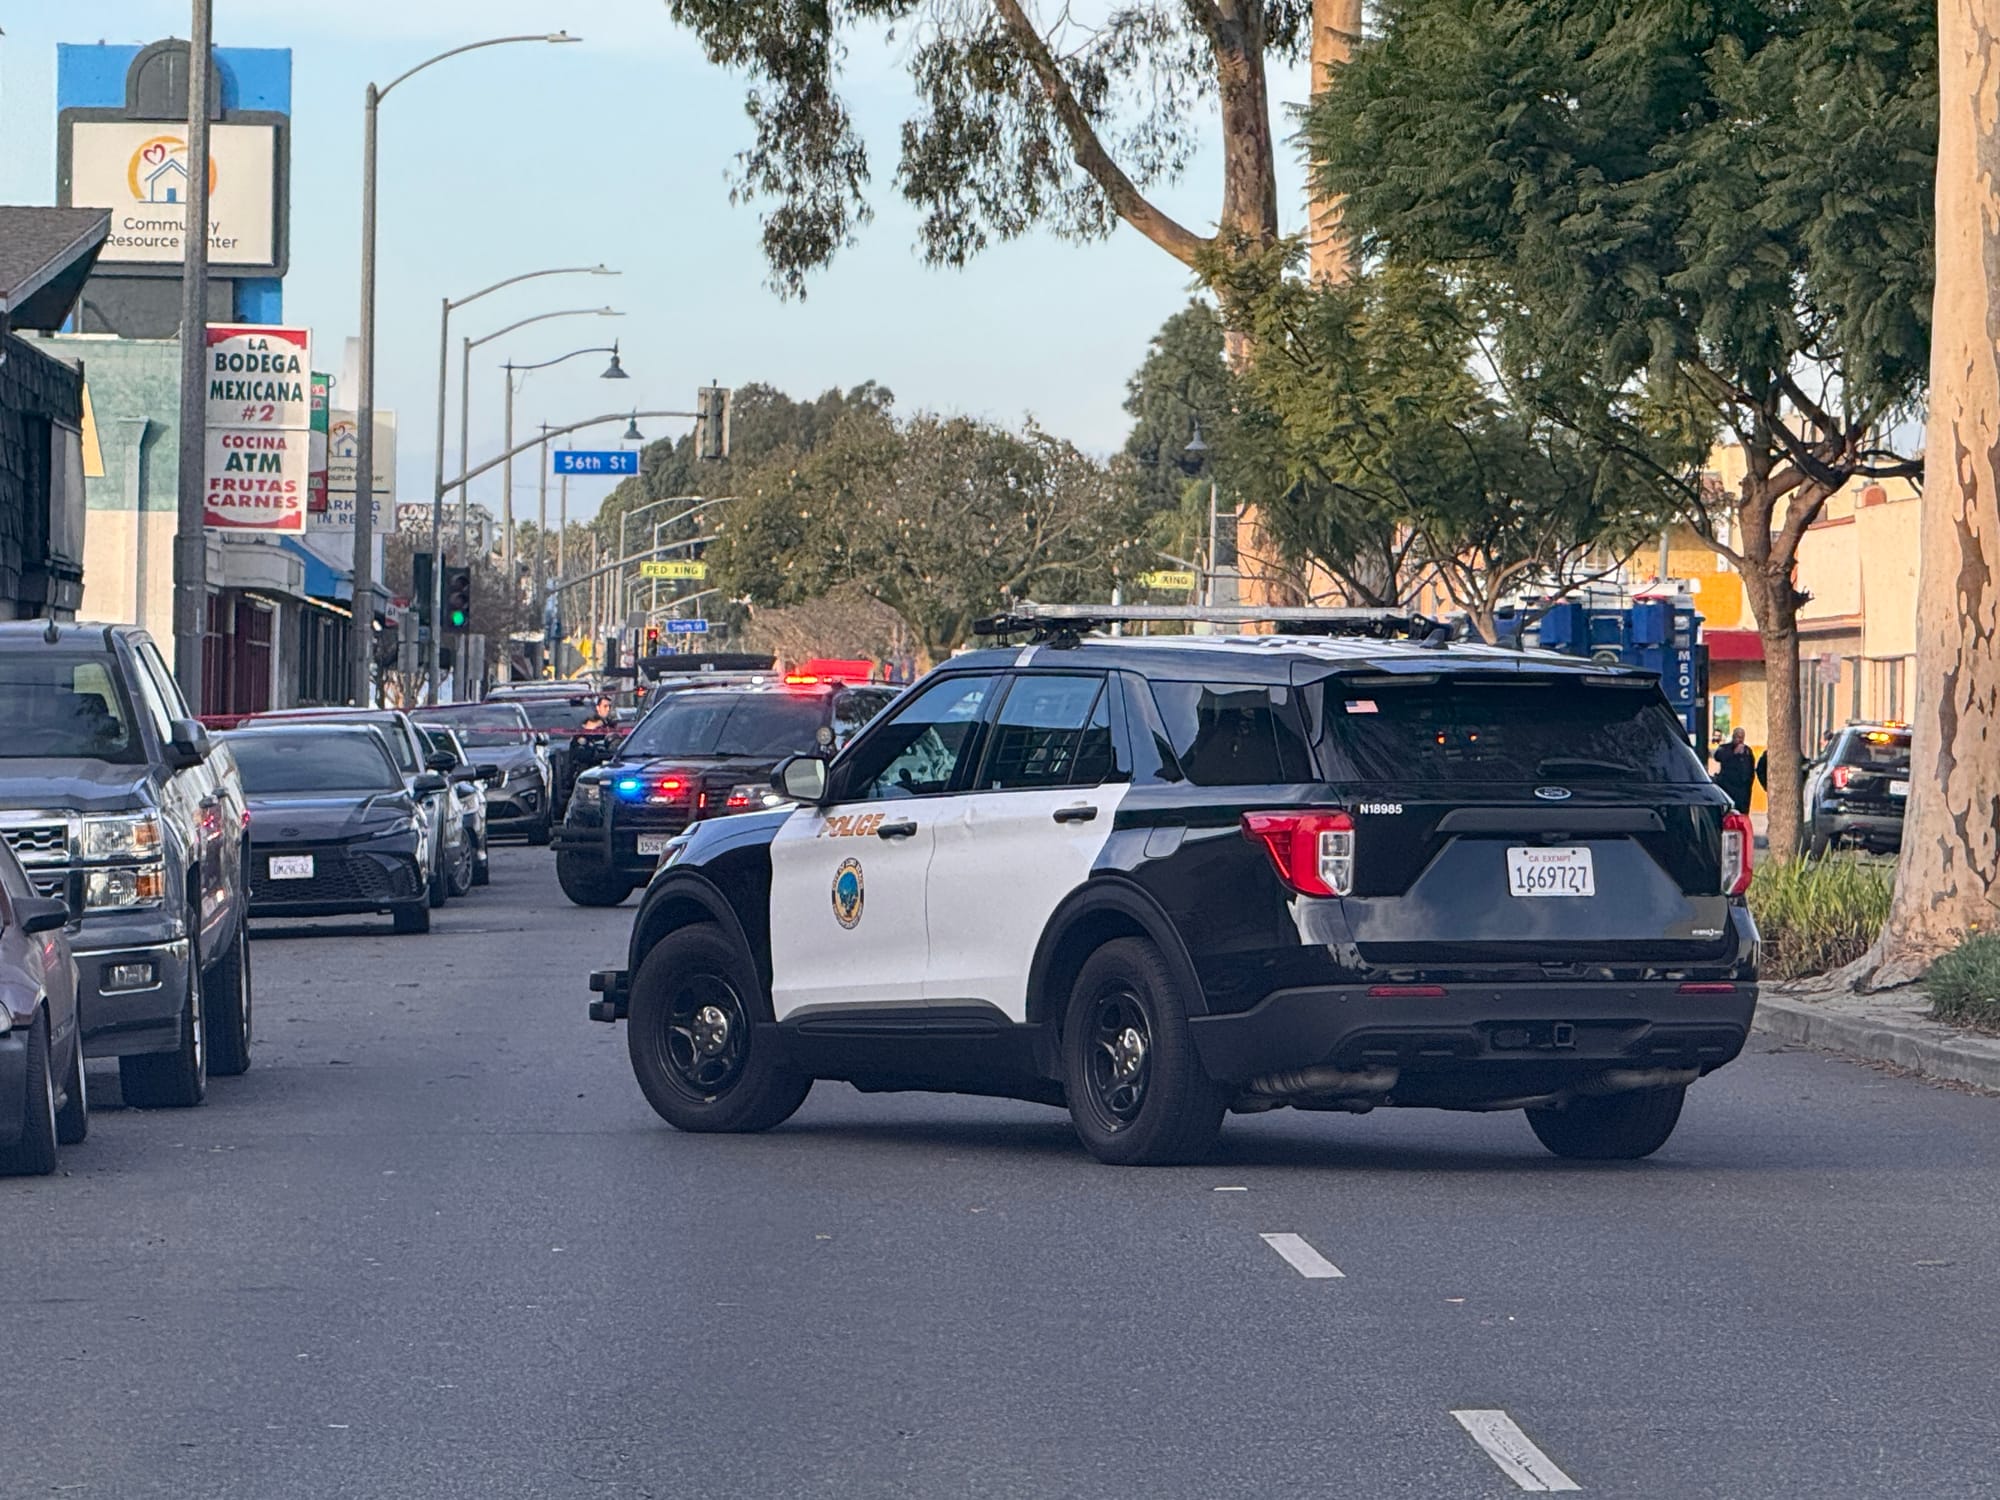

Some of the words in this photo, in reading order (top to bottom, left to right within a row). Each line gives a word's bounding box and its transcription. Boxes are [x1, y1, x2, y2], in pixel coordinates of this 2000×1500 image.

[124, 217, 219, 234] Commuy
[106, 234, 179, 247] Resource
[249, 338, 269, 351] LA
[215, 353, 301, 374] BODEGA
[210, 380, 304, 402] MEXICANA
[242, 405, 275, 422] #2
[222, 435, 288, 450] COCINA
[225, 452, 282, 473] ATM
[564, 455, 601, 470] 56th
[610, 455, 626, 470] St
[210, 479, 297, 493] FRUTAS
[207, 494, 298, 509] CARNES
[317, 513, 332, 524] IN
[338, 513, 378, 525] RER
[646, 565, 668, 575] PED
[674, 565, 698, 575] XING
[1162, 575, 1188, 585] XING
[1678, 650, 1691, 699] MEOC
[1360, 803, 1403, 815] N18985
[816, 813, 886, 838] POLICE
[1516, 865, 1588, 890] 1669727
